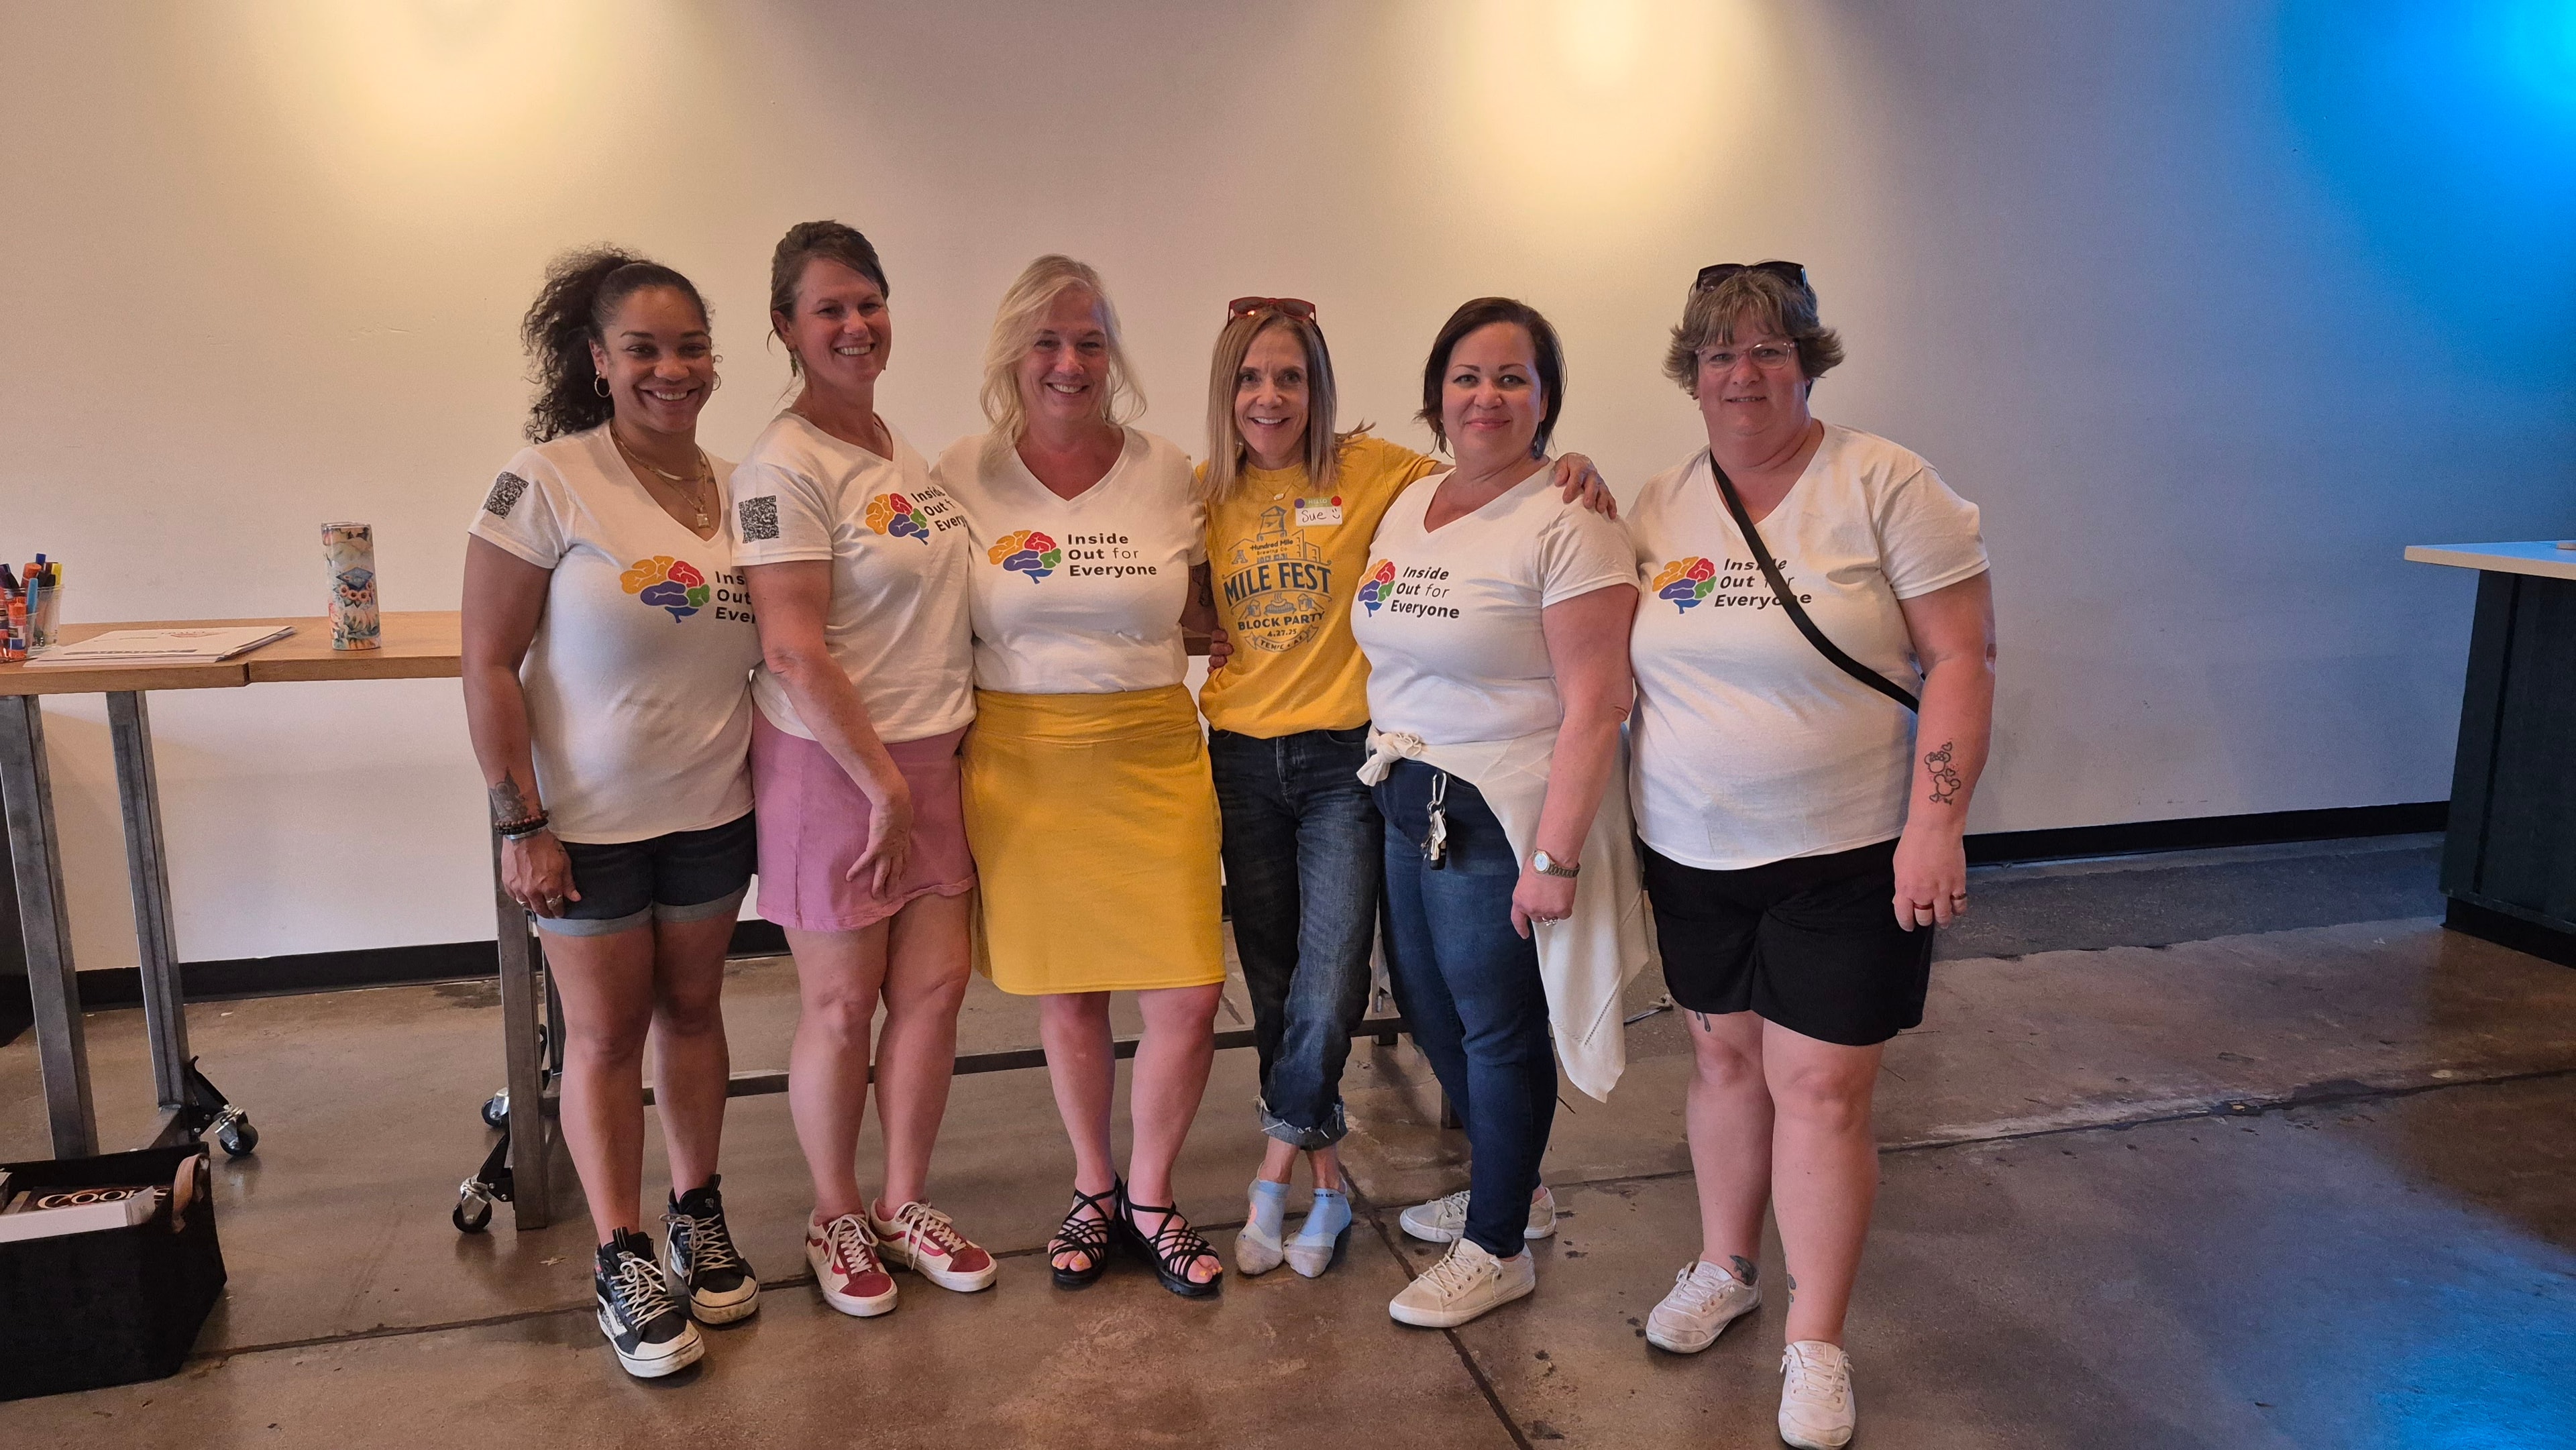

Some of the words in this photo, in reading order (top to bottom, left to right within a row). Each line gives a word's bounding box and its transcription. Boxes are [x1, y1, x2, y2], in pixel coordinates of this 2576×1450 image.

[924, 502, 949, 516] Out
[1301, 510, 1327, 522] Sue
[1068, 533, 1128, 545] Inside
[1250, 541, 1279, 551] Hundred
[1068, 549, 1104, 560] Out
[1112, 547, 1139, 559] for
[1069, 565, 1157, 578] Everyone
[1724, 558, 1787, 571] Inse
[1403, 566, 1449, 580] Inside
[1224, 565, 1272, 608] MILE
[1277, 562, 1332, 594] FEST
[1720, 575, 1755, 589] Out
[717, 589, 751, 604] Out
[1396, 582, 1421, 595] Out
[1425, 583, 1450, 598] for
[1391, 600, 1460, 618] Everyone
[1715, 594, 1812, 610] Everyoe
[1238, 618, 1281, 630] BLOCK
[1283, 611, 1325, 626] PARTY
